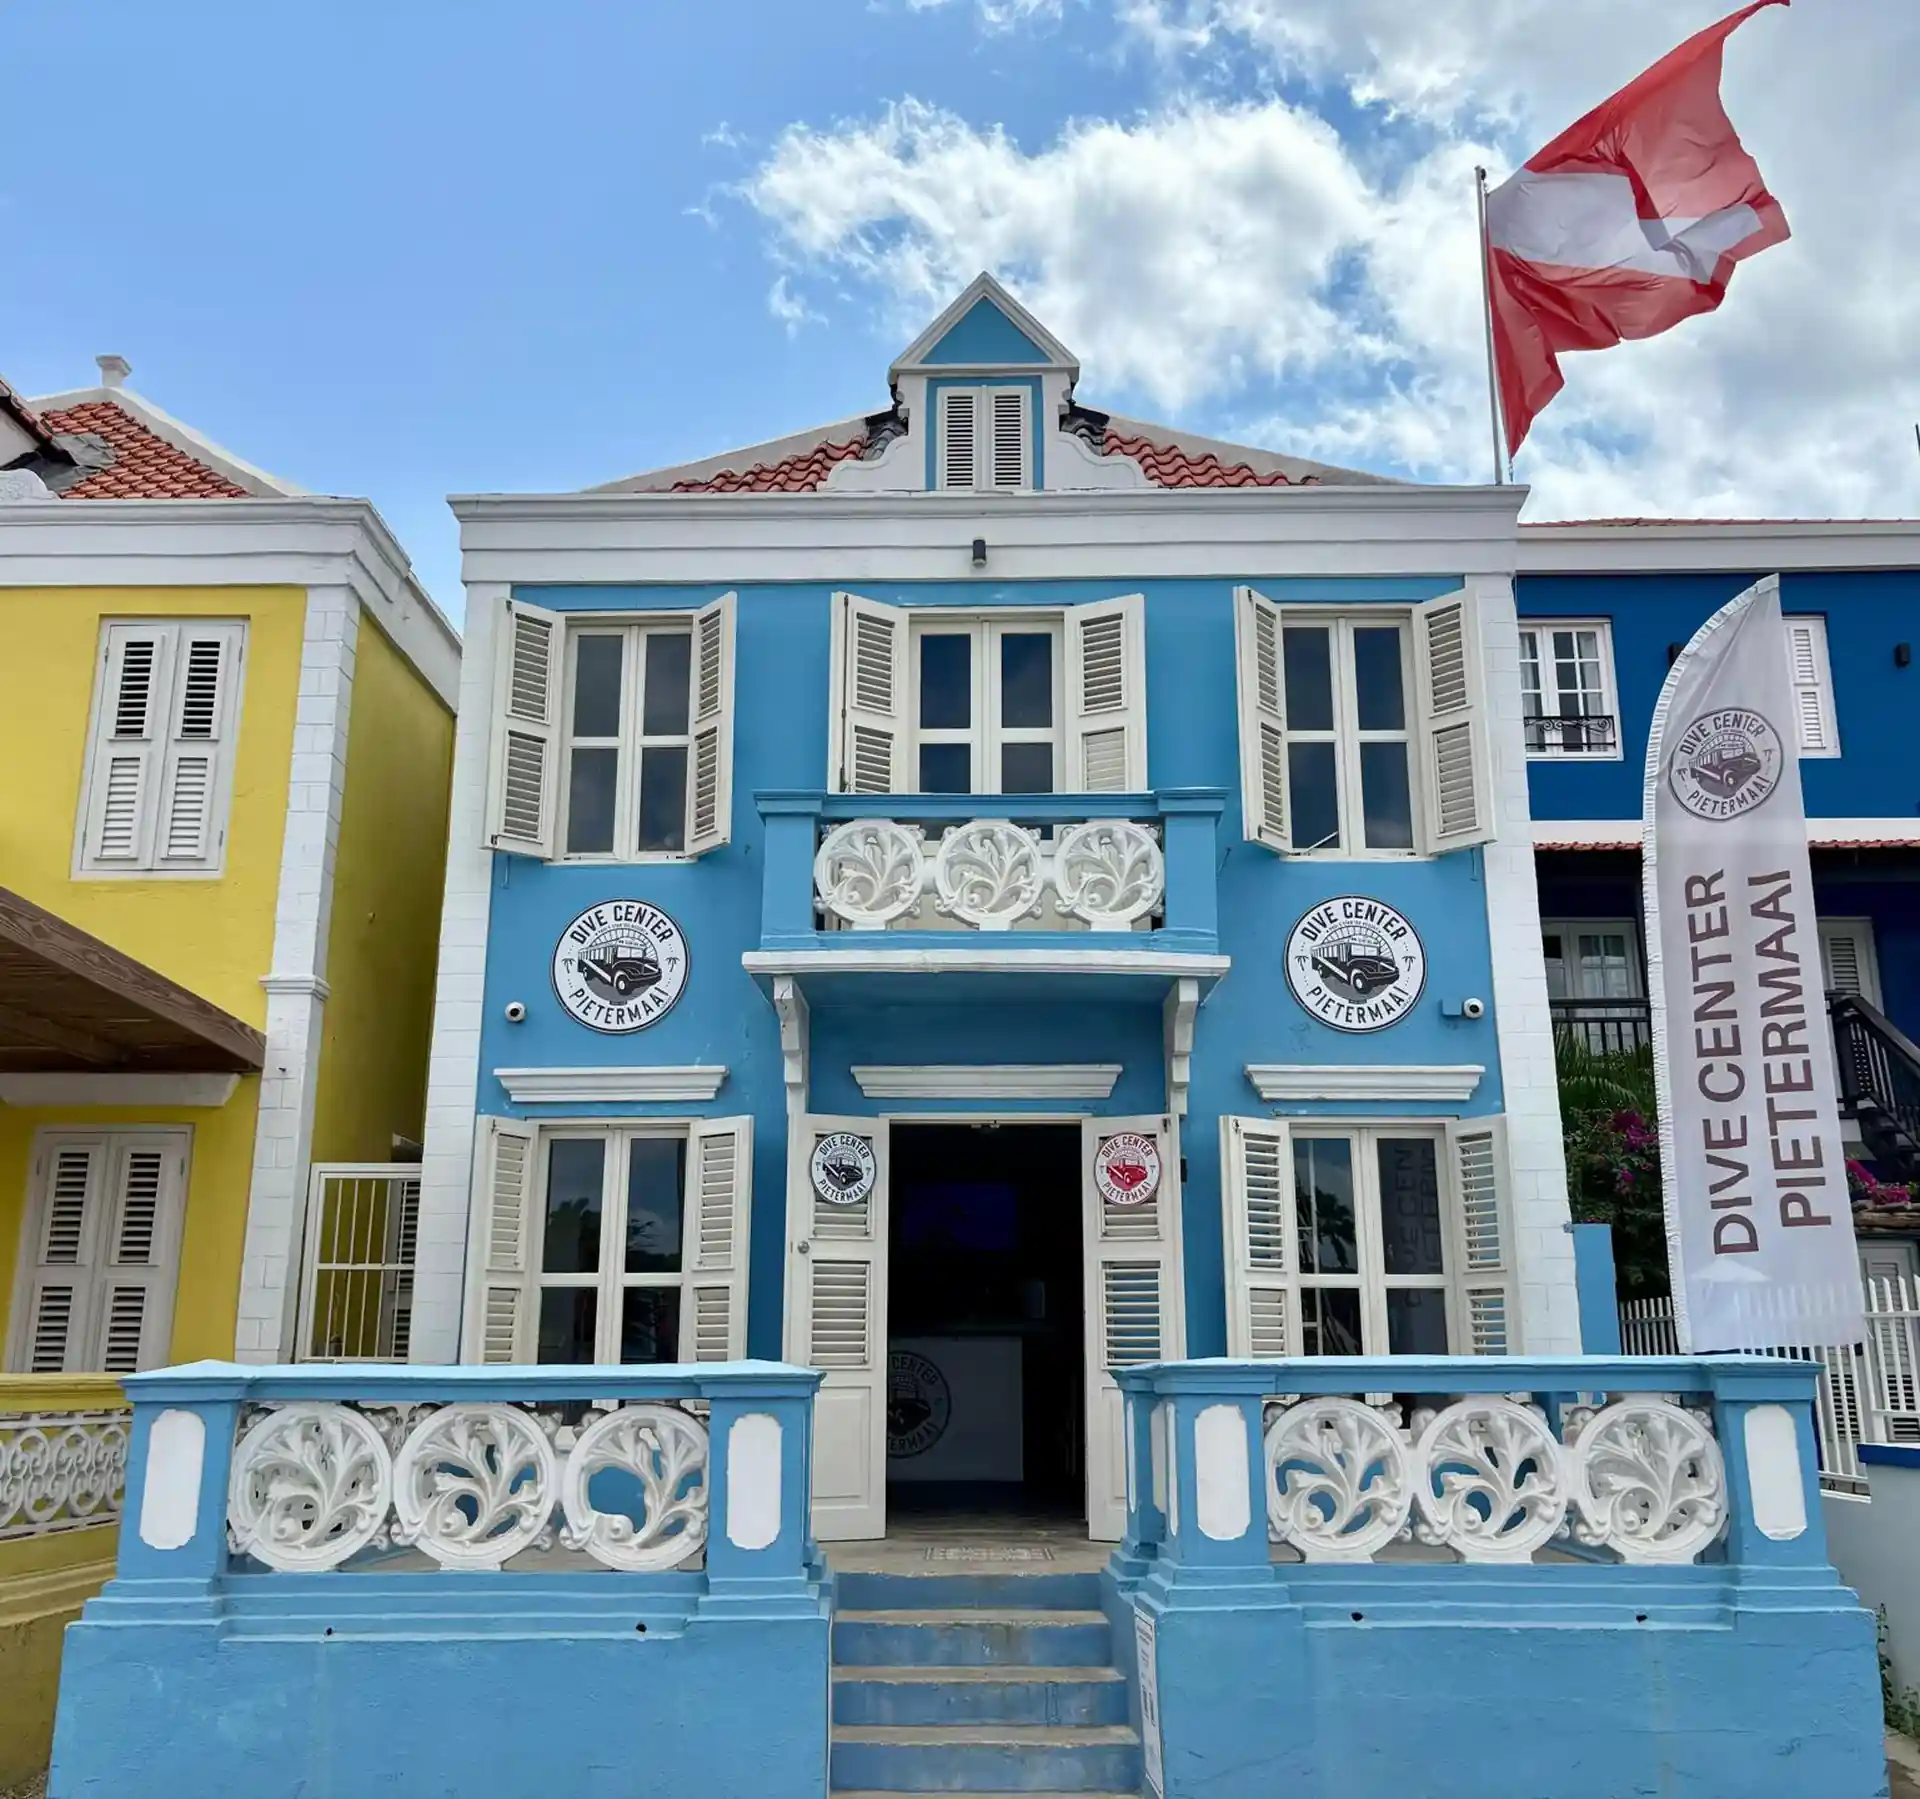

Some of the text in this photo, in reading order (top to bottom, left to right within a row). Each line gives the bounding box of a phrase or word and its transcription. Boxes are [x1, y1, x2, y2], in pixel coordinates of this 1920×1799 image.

[1680, 723, 1710, 755] DIVE
[1712, 713, 1766, 738] CENTER
[1687, 775, 1771, 815] PIETERMAAI
[570, 905, 674, 945] DIVE CENTER
[1300, 902, 1408, 941] DIVE CENTER
[568, 987, 669, 1025] PIETERMAAI
[1306, 986, 1409, 1024] PIETERMAAI
[1685, 868, 1759, 1254] DIVE CENTER
[1747, 870, 1831, 1228] PIETERMAAI
[819, 1135, 870, 1160] DIVE CENTER
[1102, 1135, 1154, 1158] DIVE CENTER
[818, 1179, 867, 1201] PIETERMAAI
[1102, 1181, 1152, 1201] PIETERMAAI
[891, 1356, 938, 1385] CENTER
